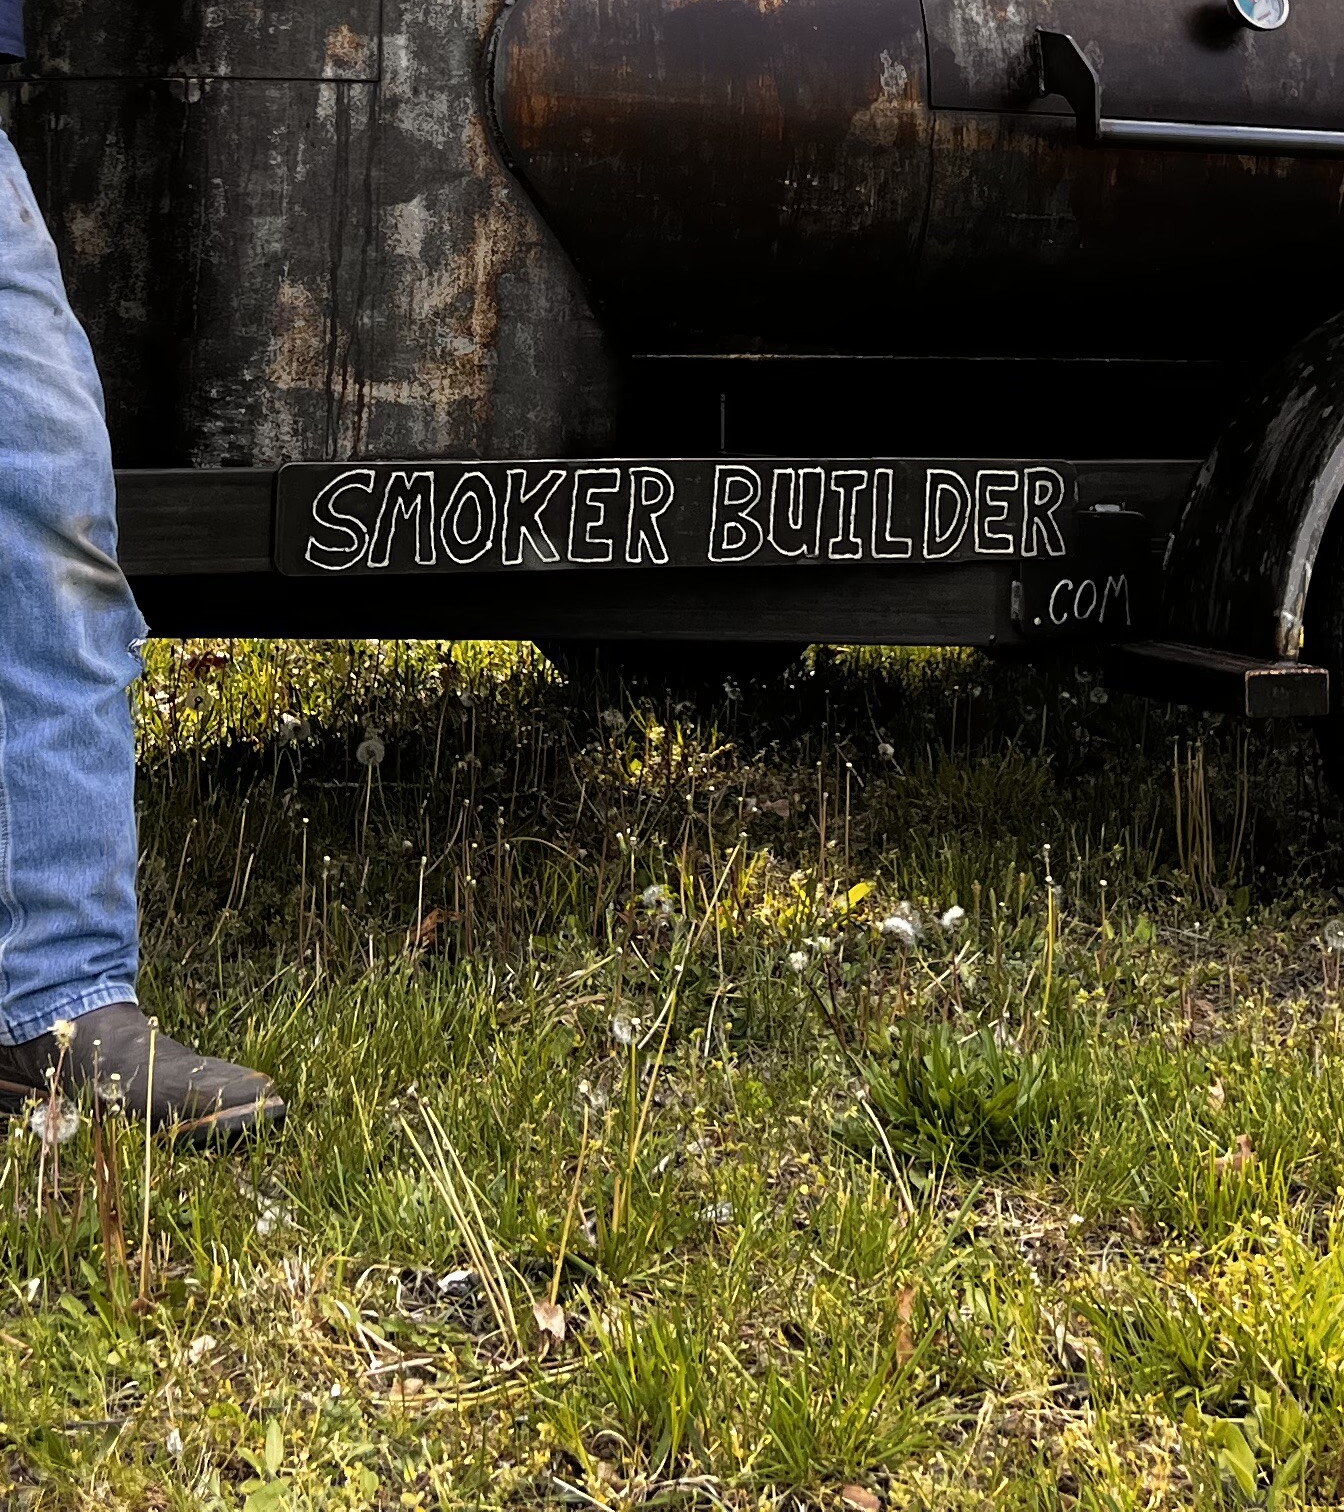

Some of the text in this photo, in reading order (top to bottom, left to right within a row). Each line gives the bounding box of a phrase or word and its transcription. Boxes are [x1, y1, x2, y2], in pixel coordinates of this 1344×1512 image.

[305, 465, 1065, 570] SMOKER BUILDER
[1034, 573, 1131, 625] .COM
